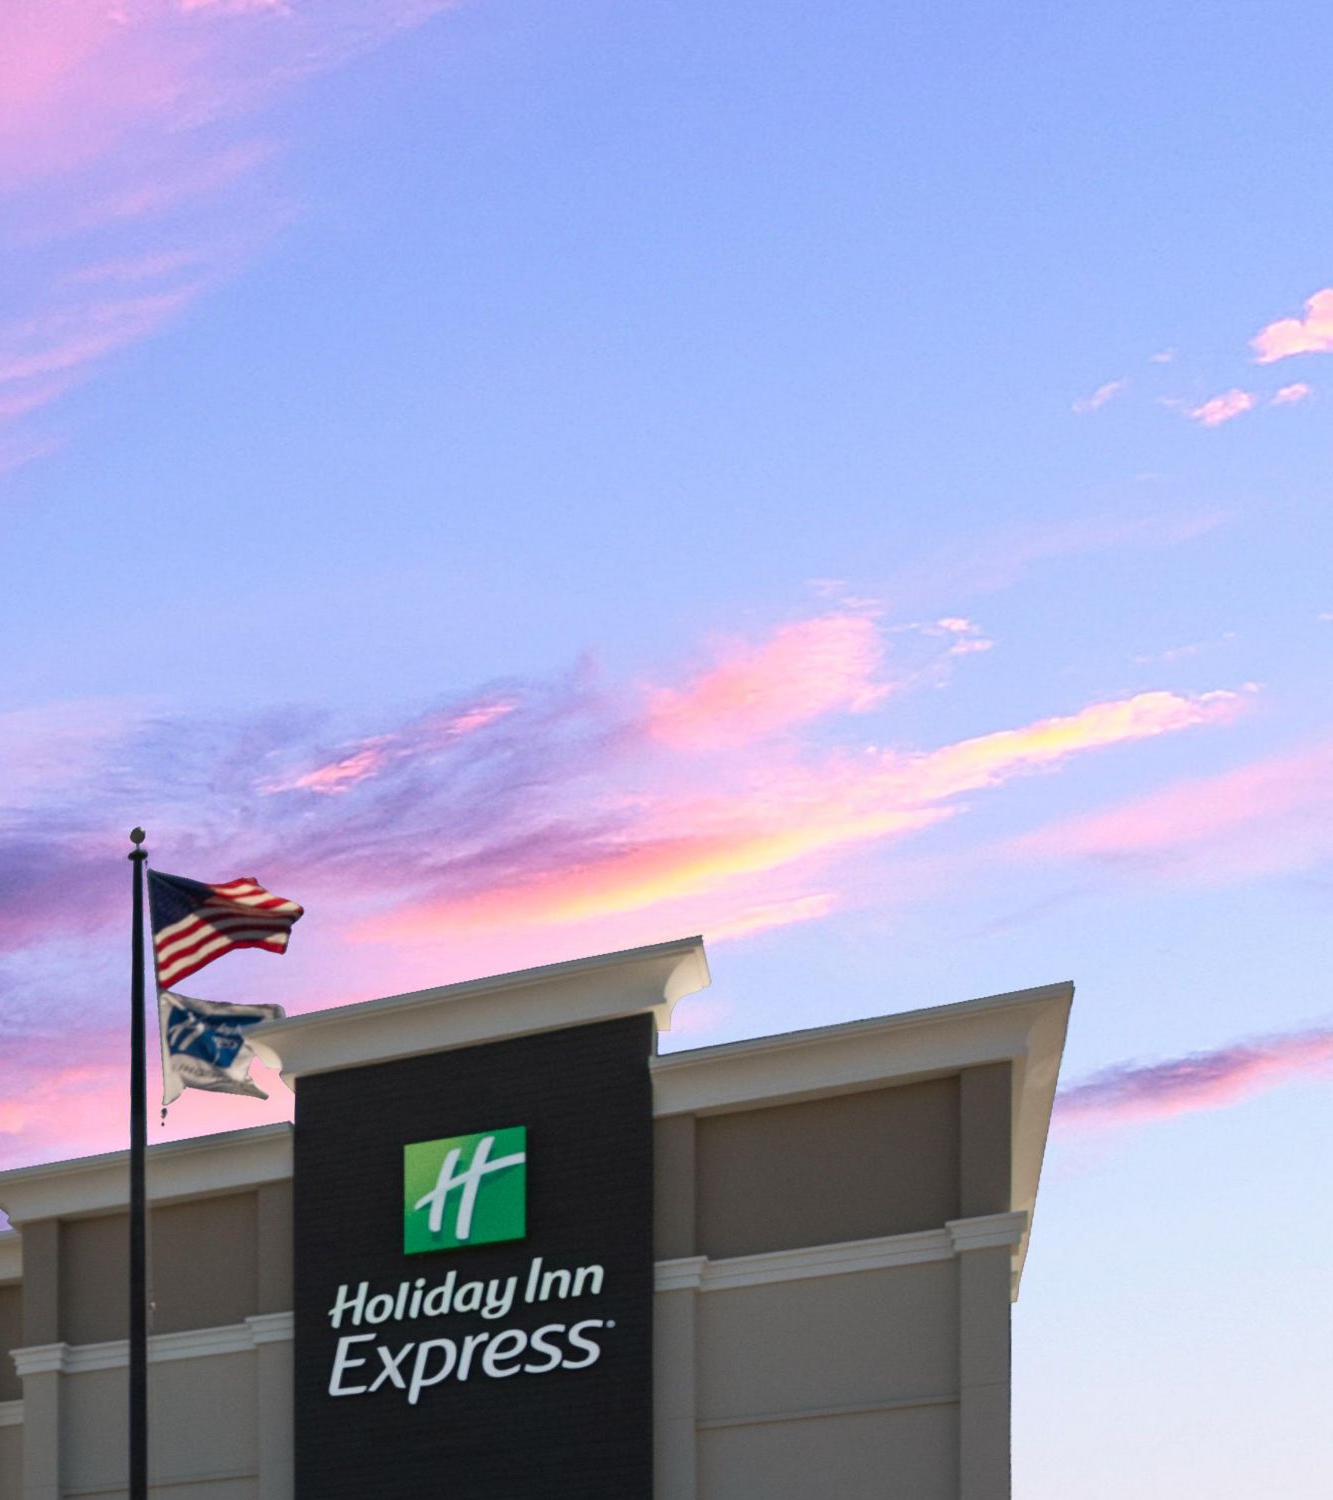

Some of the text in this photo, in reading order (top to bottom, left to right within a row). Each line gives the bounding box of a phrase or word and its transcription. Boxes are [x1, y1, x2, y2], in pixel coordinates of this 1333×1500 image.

[328, 1257, 604, 1329] Holiday Inn
[328, 1319, 605, 1405] Express
